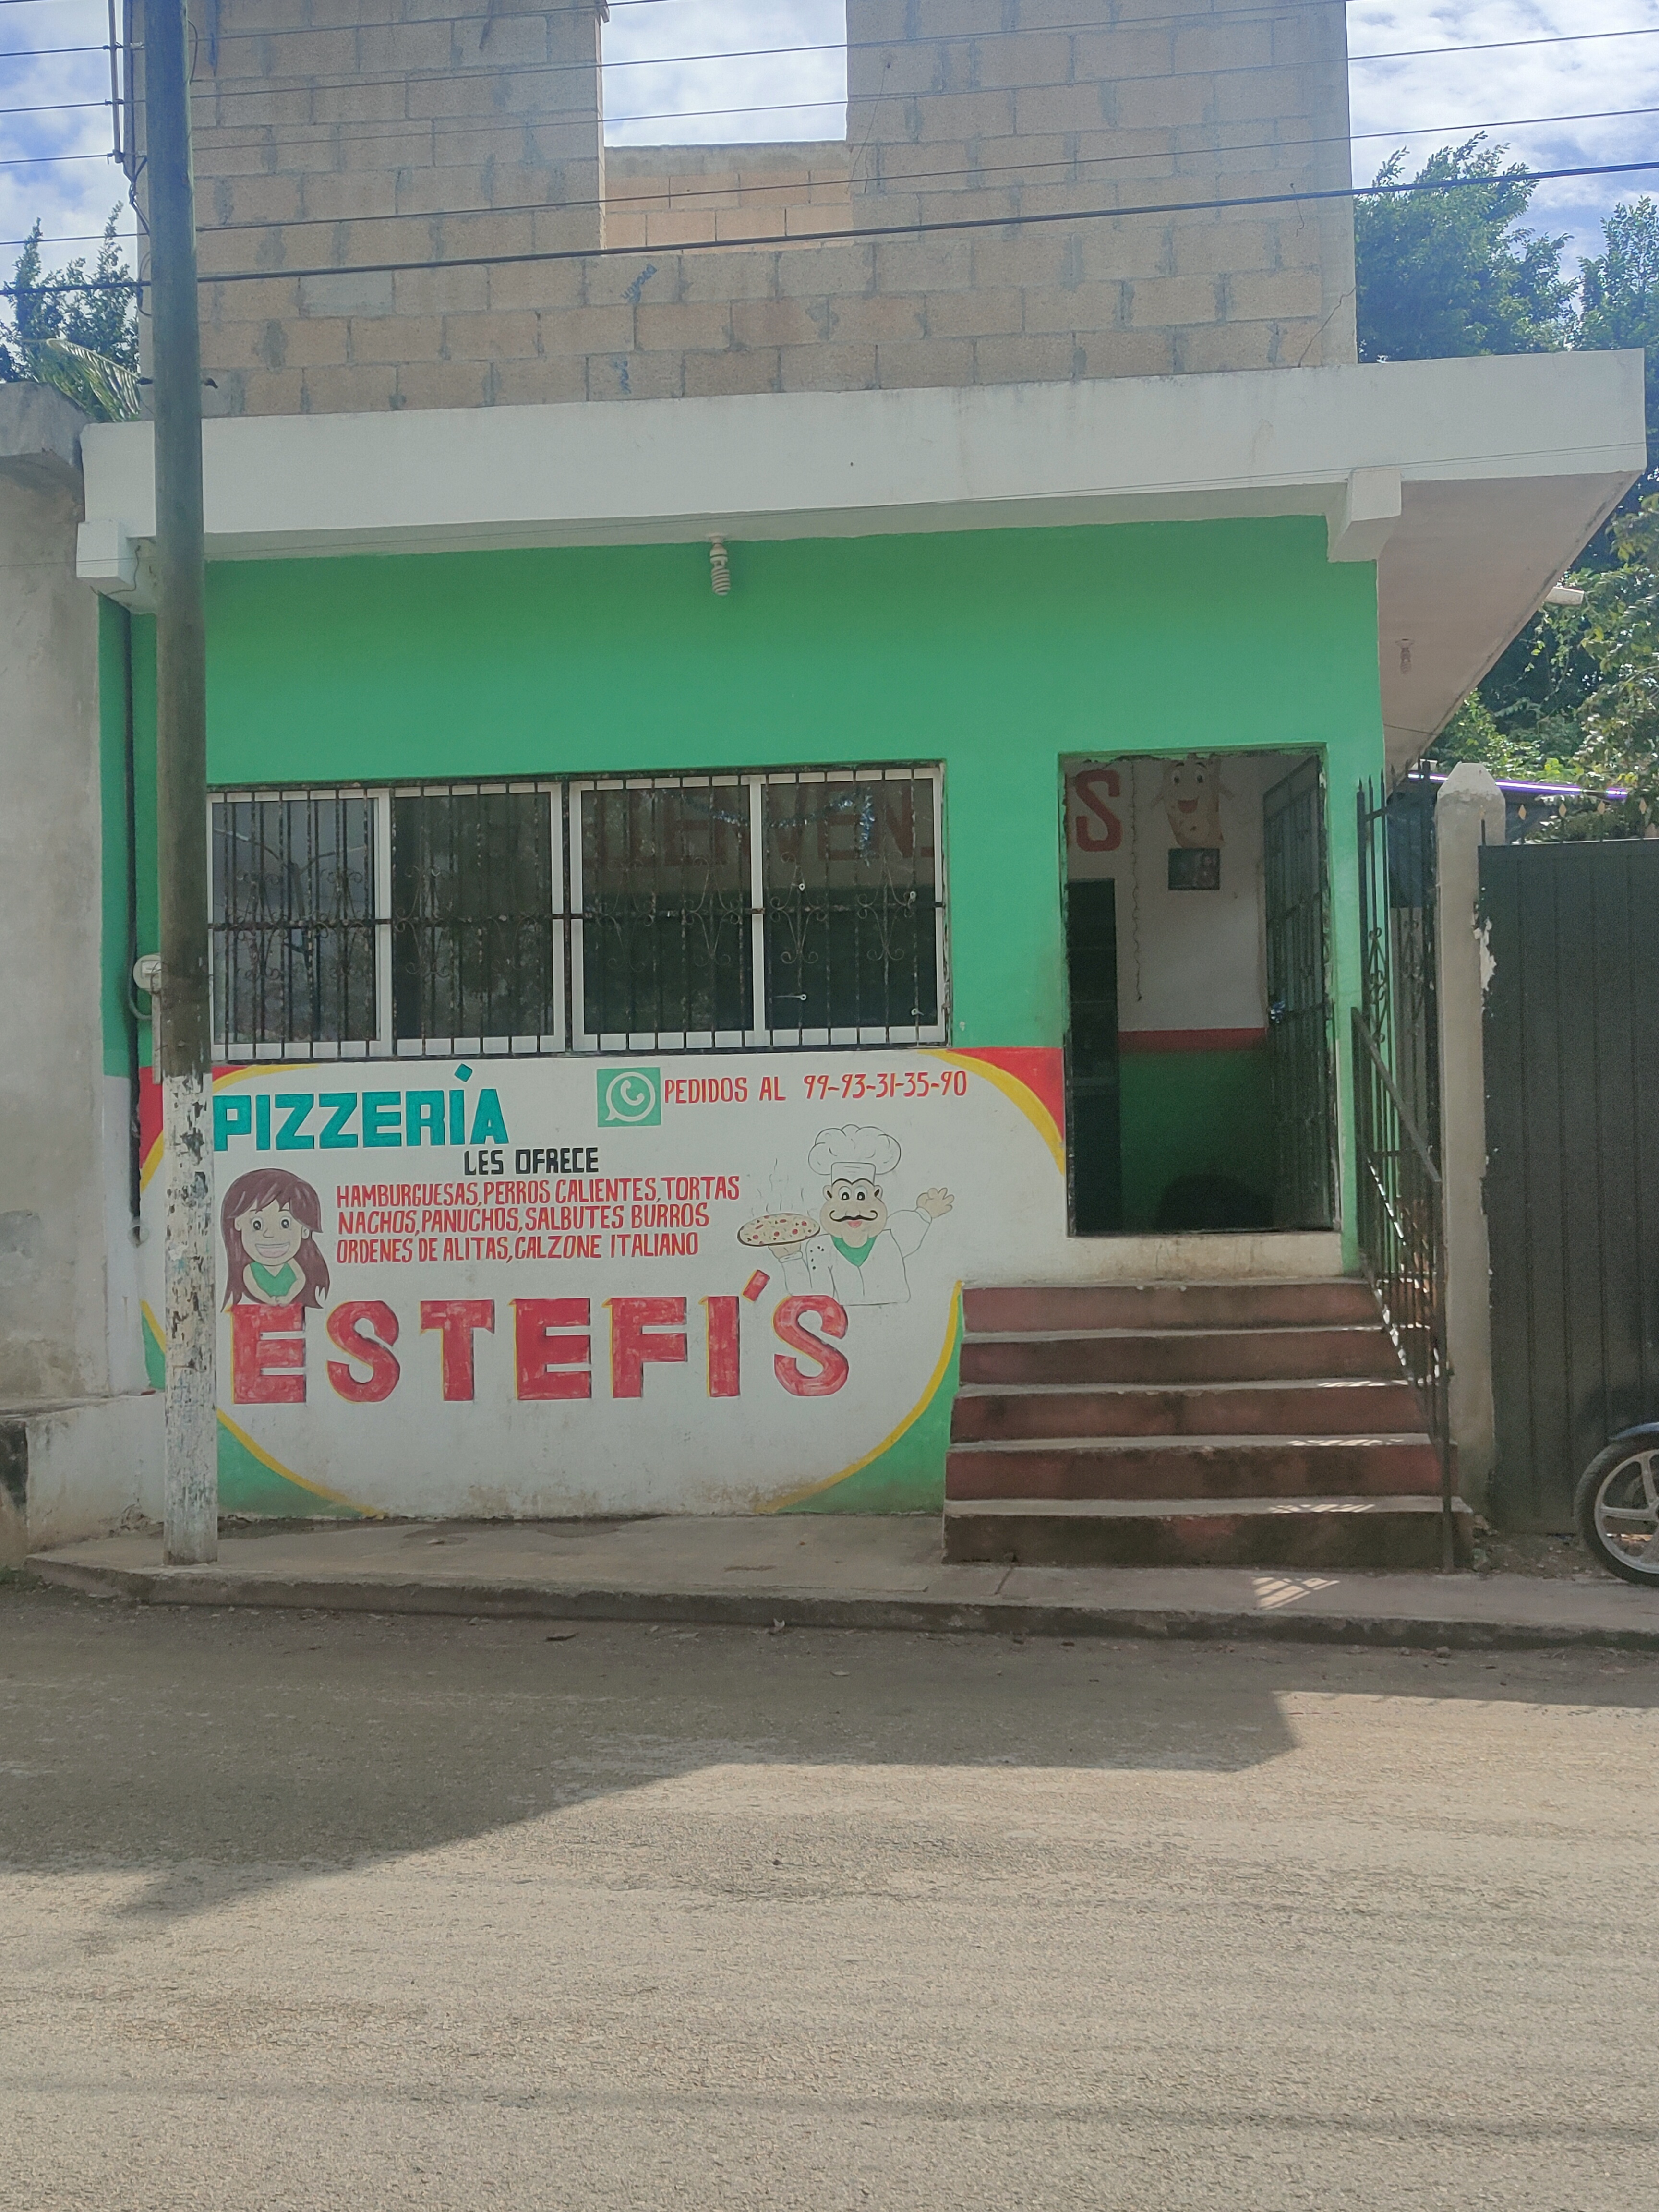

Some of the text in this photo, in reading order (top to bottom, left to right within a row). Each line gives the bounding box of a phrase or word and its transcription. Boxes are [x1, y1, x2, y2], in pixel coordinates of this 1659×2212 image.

[664, 1070, 968, 1104] PEDIDOS AL 99-93-31-35-90
[464, 1147, 599, 1175] LES OFRECE
[631, 1202, 710, 1228] BURROS
[336, 1238, 413, 1263] ORDENES
[419, 1238, 438, 1262] DE
[611, 1232, 699, 1257] ITALIANO
